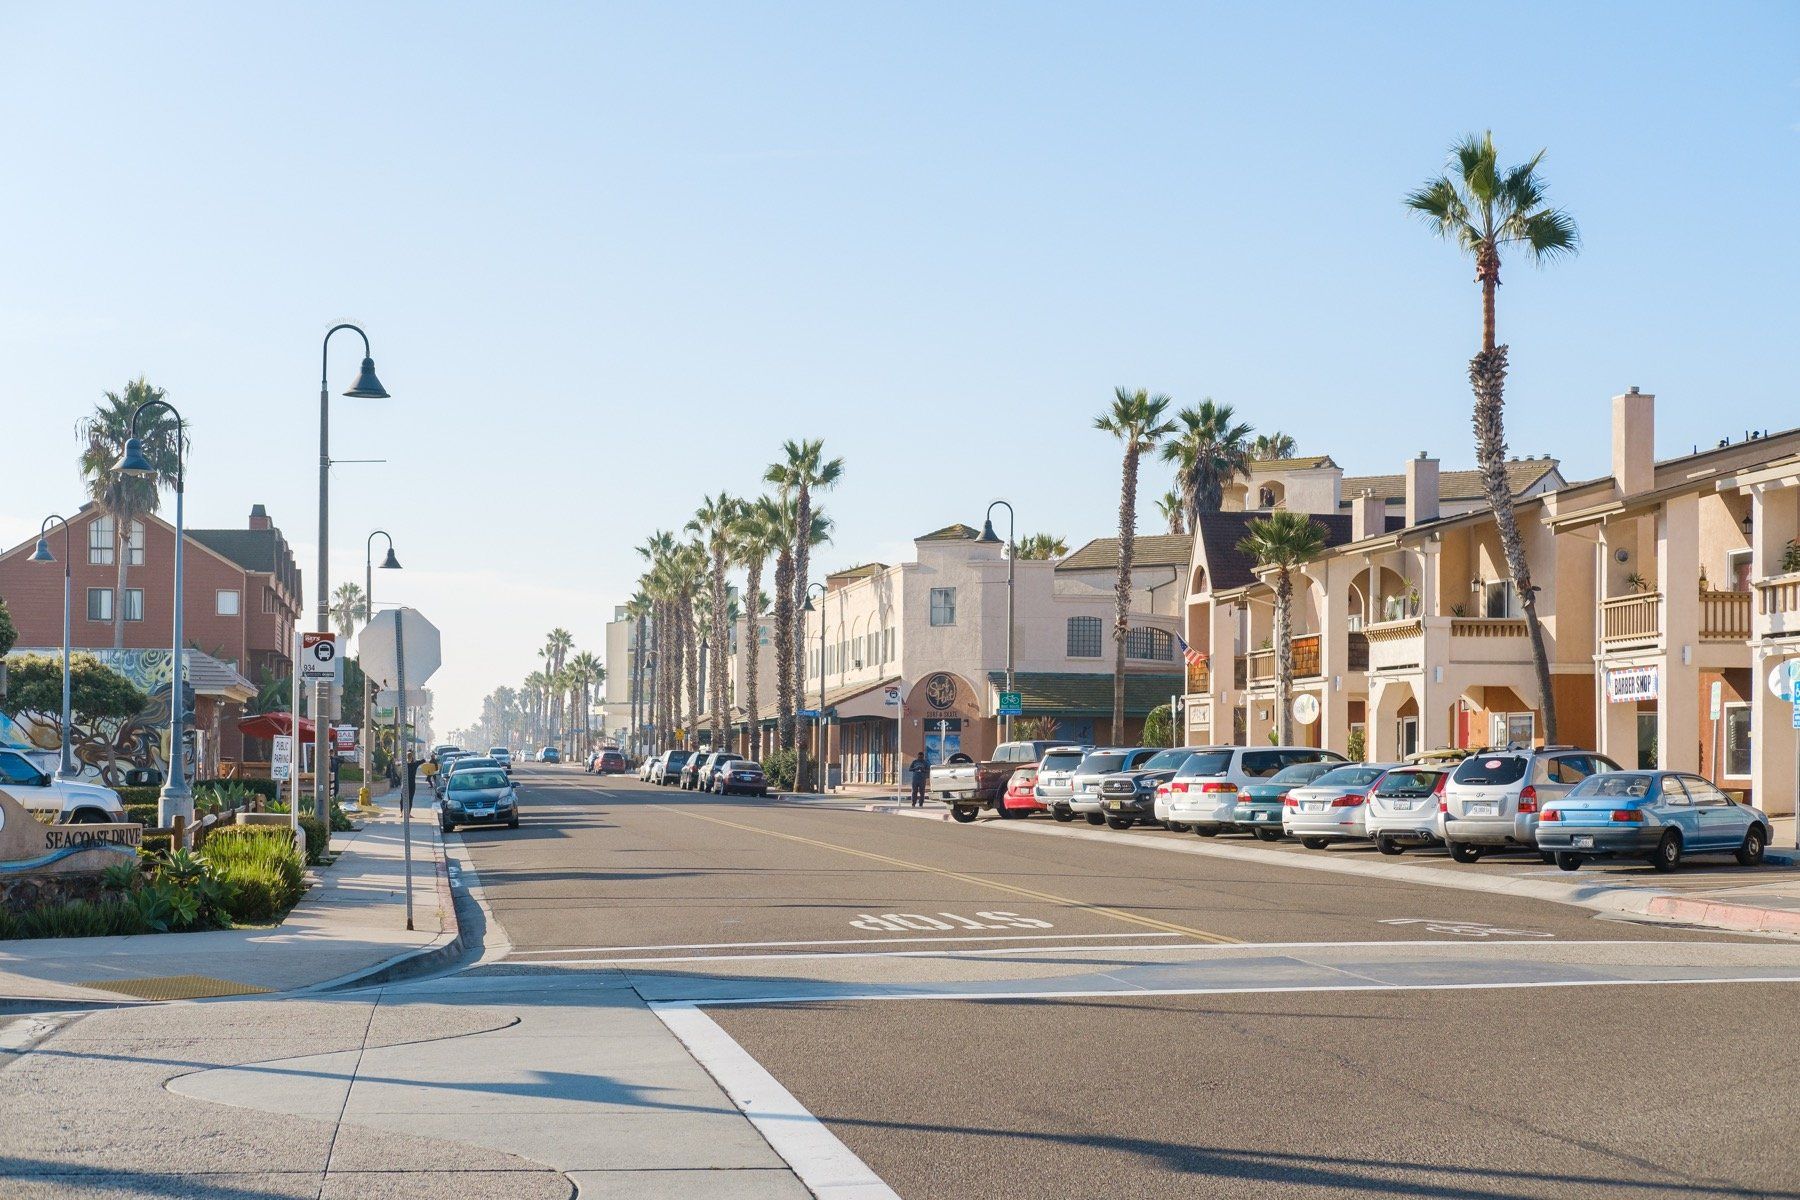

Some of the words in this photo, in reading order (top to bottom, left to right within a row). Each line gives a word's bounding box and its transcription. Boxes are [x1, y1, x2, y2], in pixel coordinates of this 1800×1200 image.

[1614, 676, 1635, 695] BARBER
[1636, 674, 1652, 693] SHOP
[275, 741, 289, 751] PUBLIC
[273, 753, 290, 764] PARKING
[273, 766, 283, 776] HERE
[46, 830, 109, 849] SEACOAST
[112, 828, 140, 845] DRIVE
[849, 911, 1054, 931] STOP
